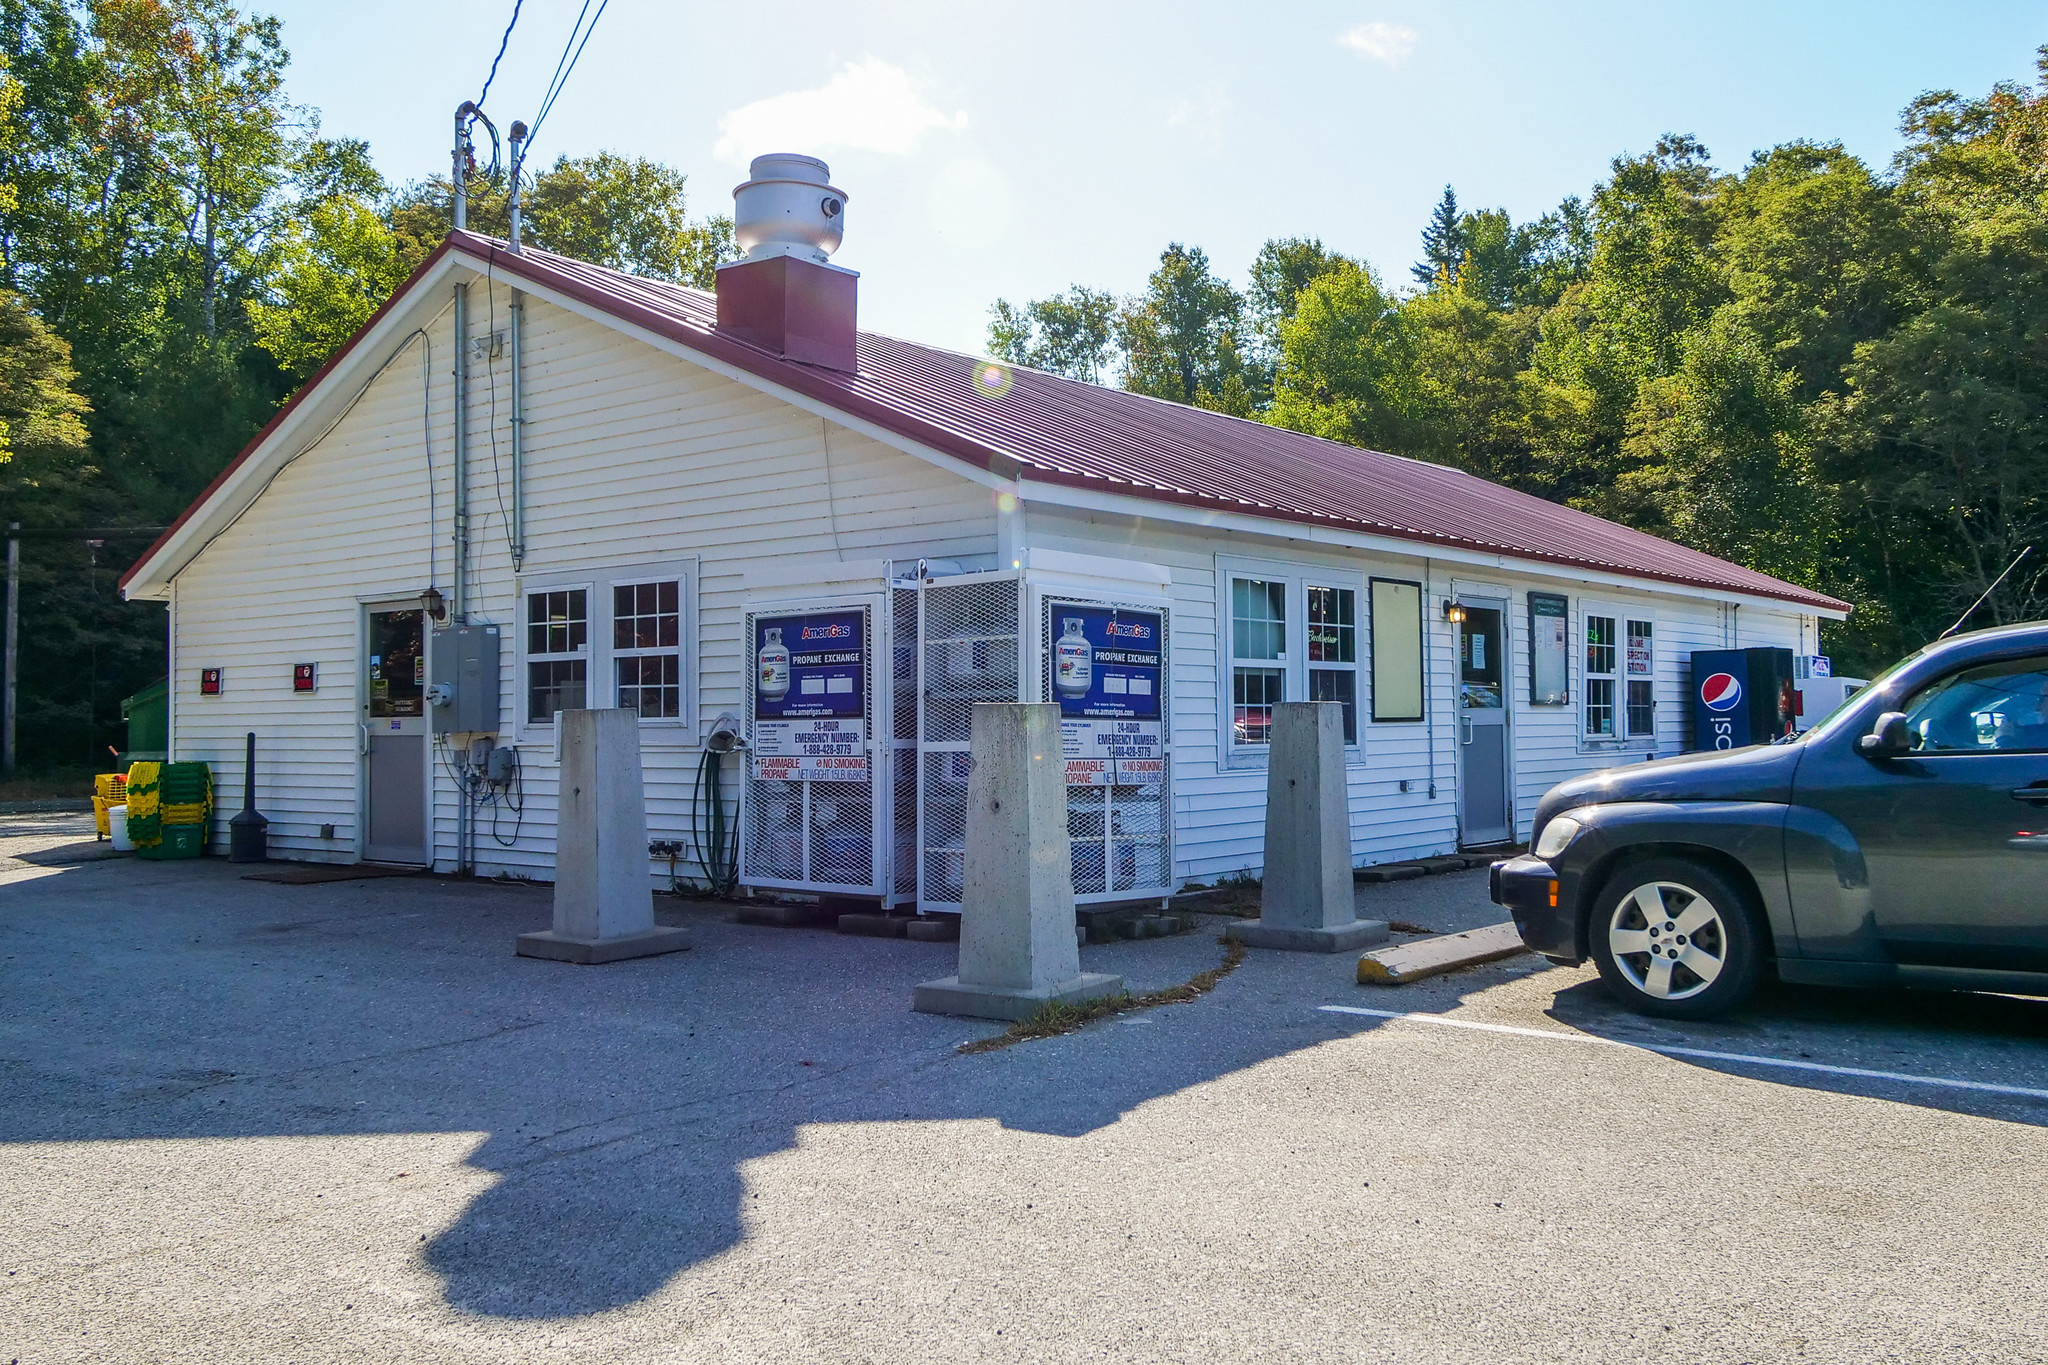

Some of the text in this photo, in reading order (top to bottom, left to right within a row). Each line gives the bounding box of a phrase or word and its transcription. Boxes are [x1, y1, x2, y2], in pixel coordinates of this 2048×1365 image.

[801, 624, 851, 640] AmeriGas
[1106, 622, 1151, 639] AmeriGas
[792, 653, 860, 665] PROPANE EXCHANGE
[1095, 651, 1158, 665] PROPANE EXCHANGE
[783, 707, 834, 718] www.amerigas.com
[1084, 707, 1135, 718] www.amerigas.com
[813, 721, 840, 731] 24-HOUR
[1117, 722, 1141, 733] 24-HOUR
[795, 732, 830, 743] EMERGENCY
[831, 732, 860, 743] NUMBER:
[1097, 734, 1132, 745] EMERGENCY
[1132, 735, 1159, 746] NUMBER:
[803, 744, 852, 755] 1-888-428-9779
[1107, 746, 1152, 757] 1-888-428-9779
[761, 758, 800, 769] FLAMMABLE
[822, 758, 866, 769] NO SMOKING
[1065, 760, 1105, 772] AMMABLE
[1127, 760, 1163, 772] NO SMOKING
[761, 769, 789, 780] PROPANE
[797, 769, 809, 780] NET
[809, 769, 831, 780] WEIGHT
[1064, 772, 1093, 784] OPANE
